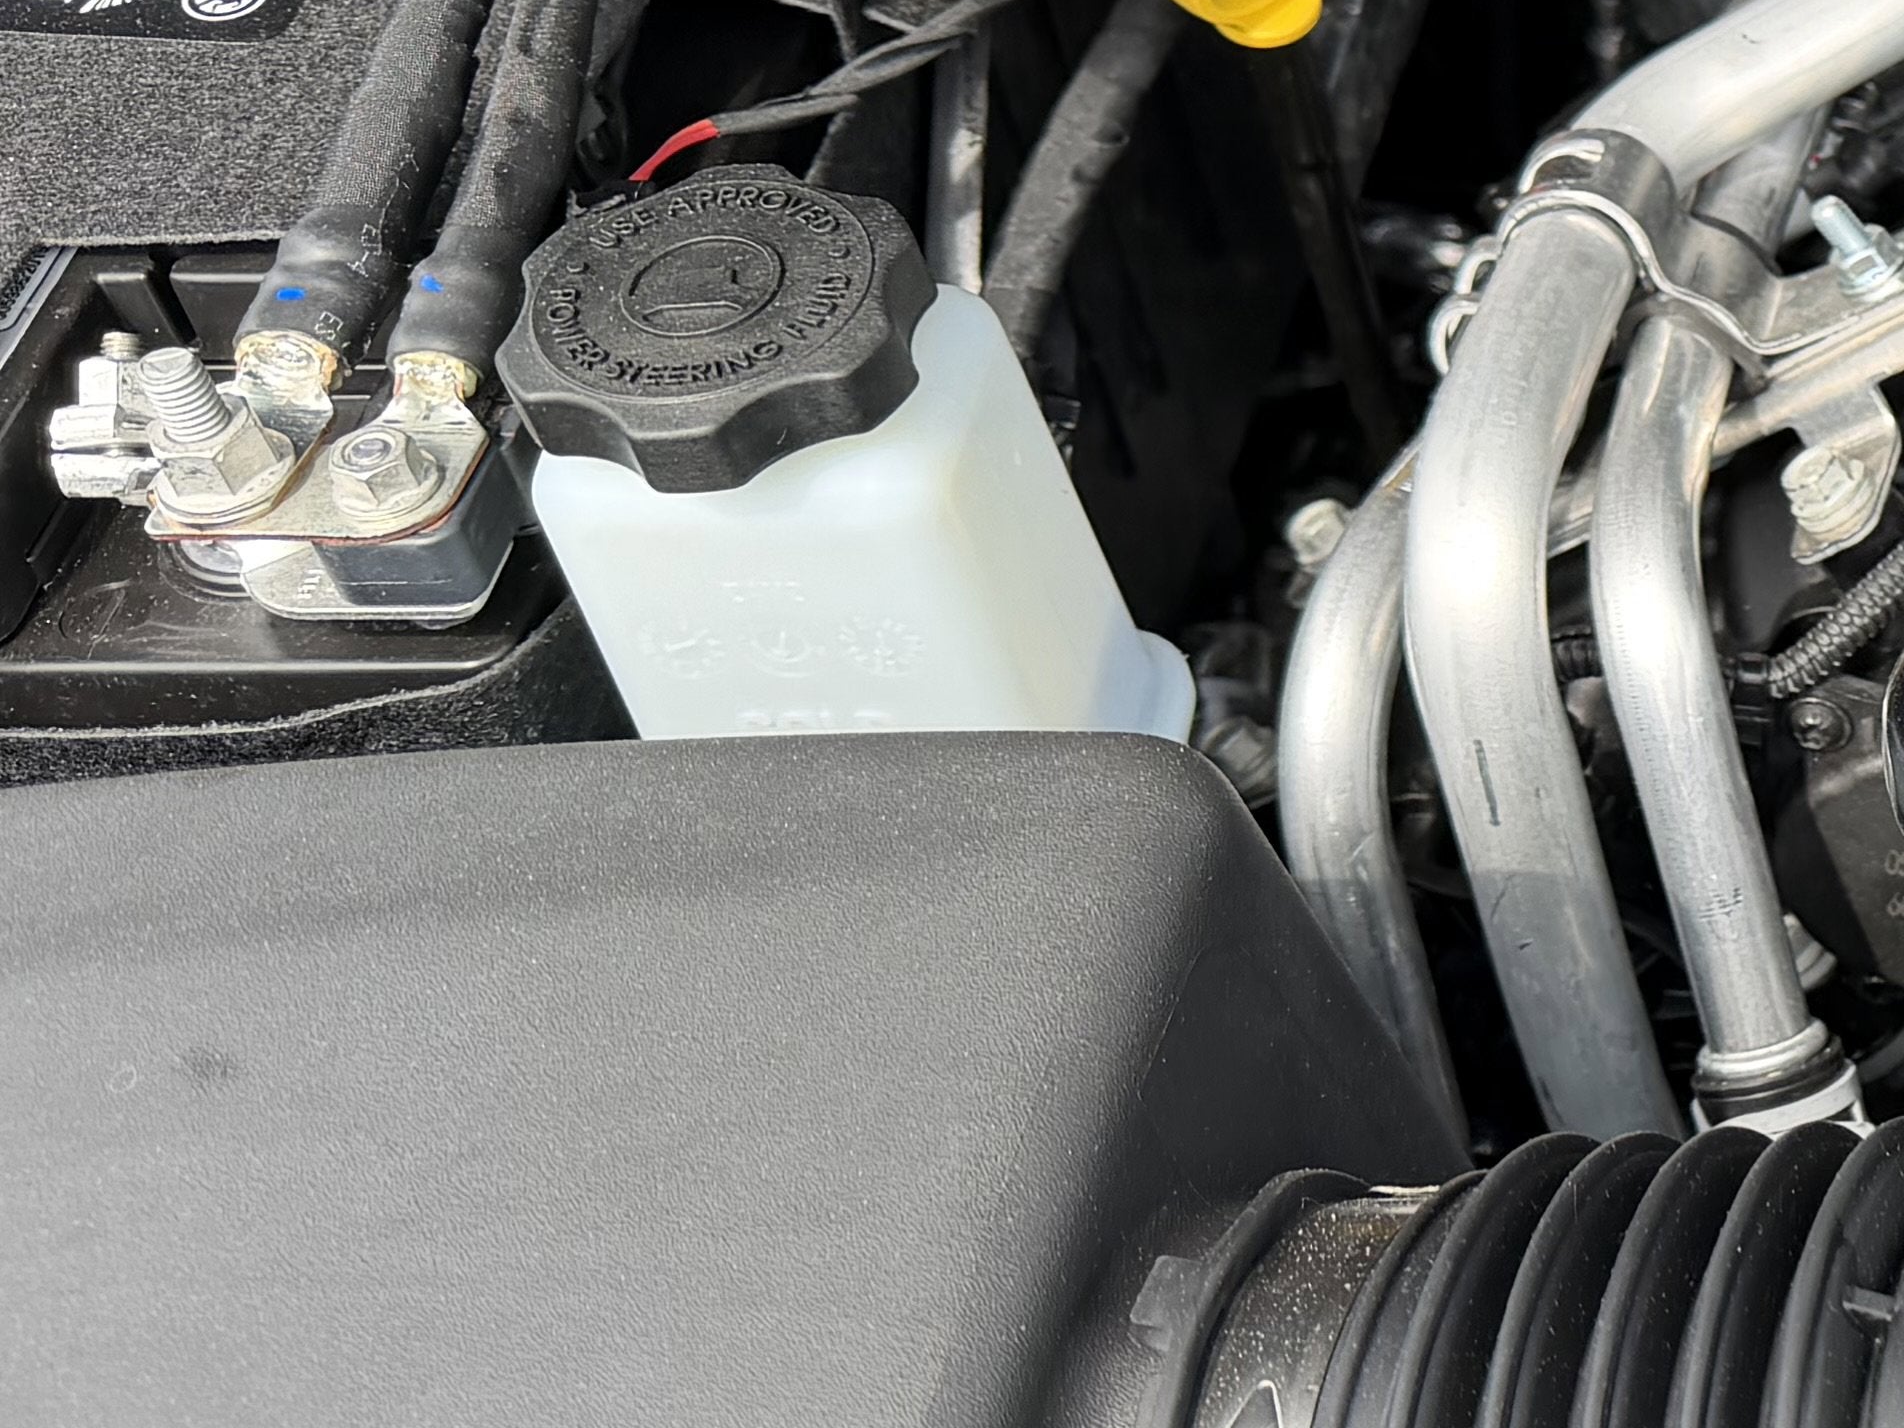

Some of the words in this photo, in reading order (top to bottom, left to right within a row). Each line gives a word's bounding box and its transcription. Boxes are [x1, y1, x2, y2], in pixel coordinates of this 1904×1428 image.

[588, 207, 657, 250] USE
[667, 185, 841, 234] APPROVED
[545, 287, 610, 372] POWER
[605, 340, 784, 386] STEERING
[782, 271, 852, 341] FLUID
